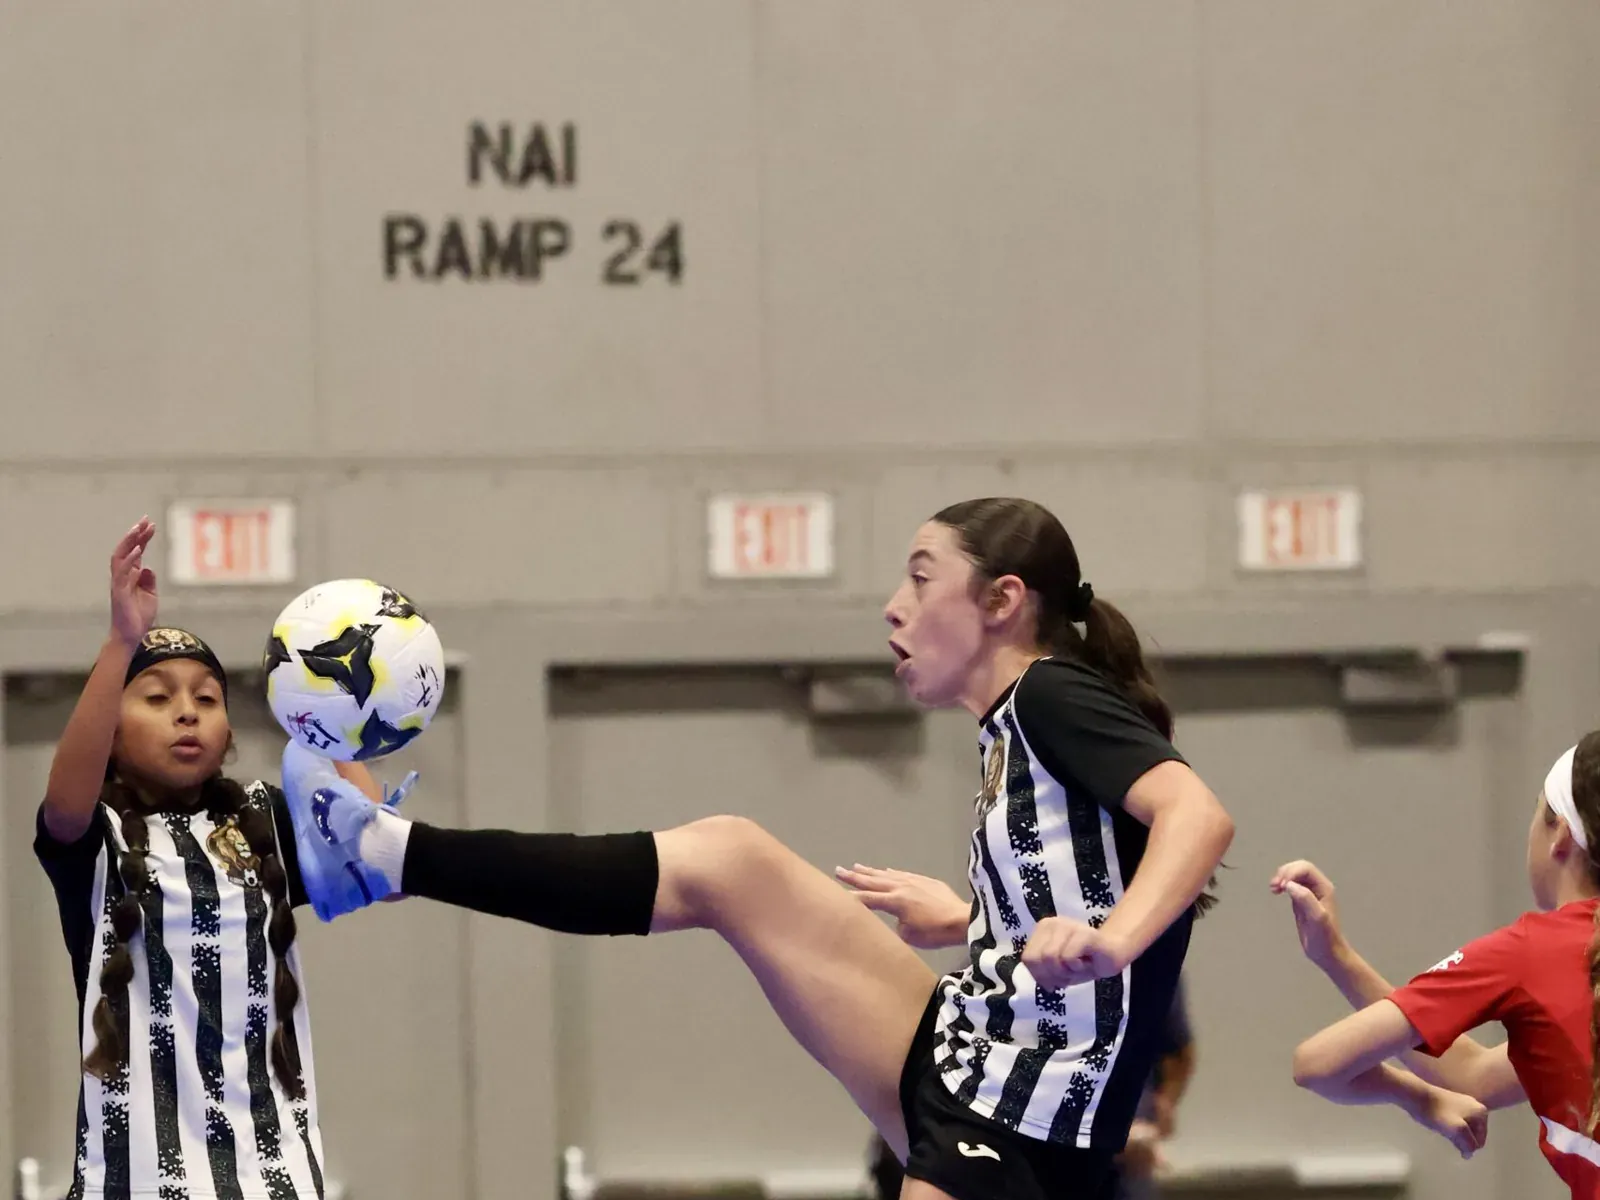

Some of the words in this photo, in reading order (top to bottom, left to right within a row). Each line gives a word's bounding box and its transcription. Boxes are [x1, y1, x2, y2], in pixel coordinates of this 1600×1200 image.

[468, 119, 576, 188] NAI
[383, 214, 572, 283] RAMP
[600, 218, 684, 285] 24
[192, 508, 271, 578] EXIT
[735, 502, 811, 573] EXIT
[1266, 494, 1340, 565] EXIT
